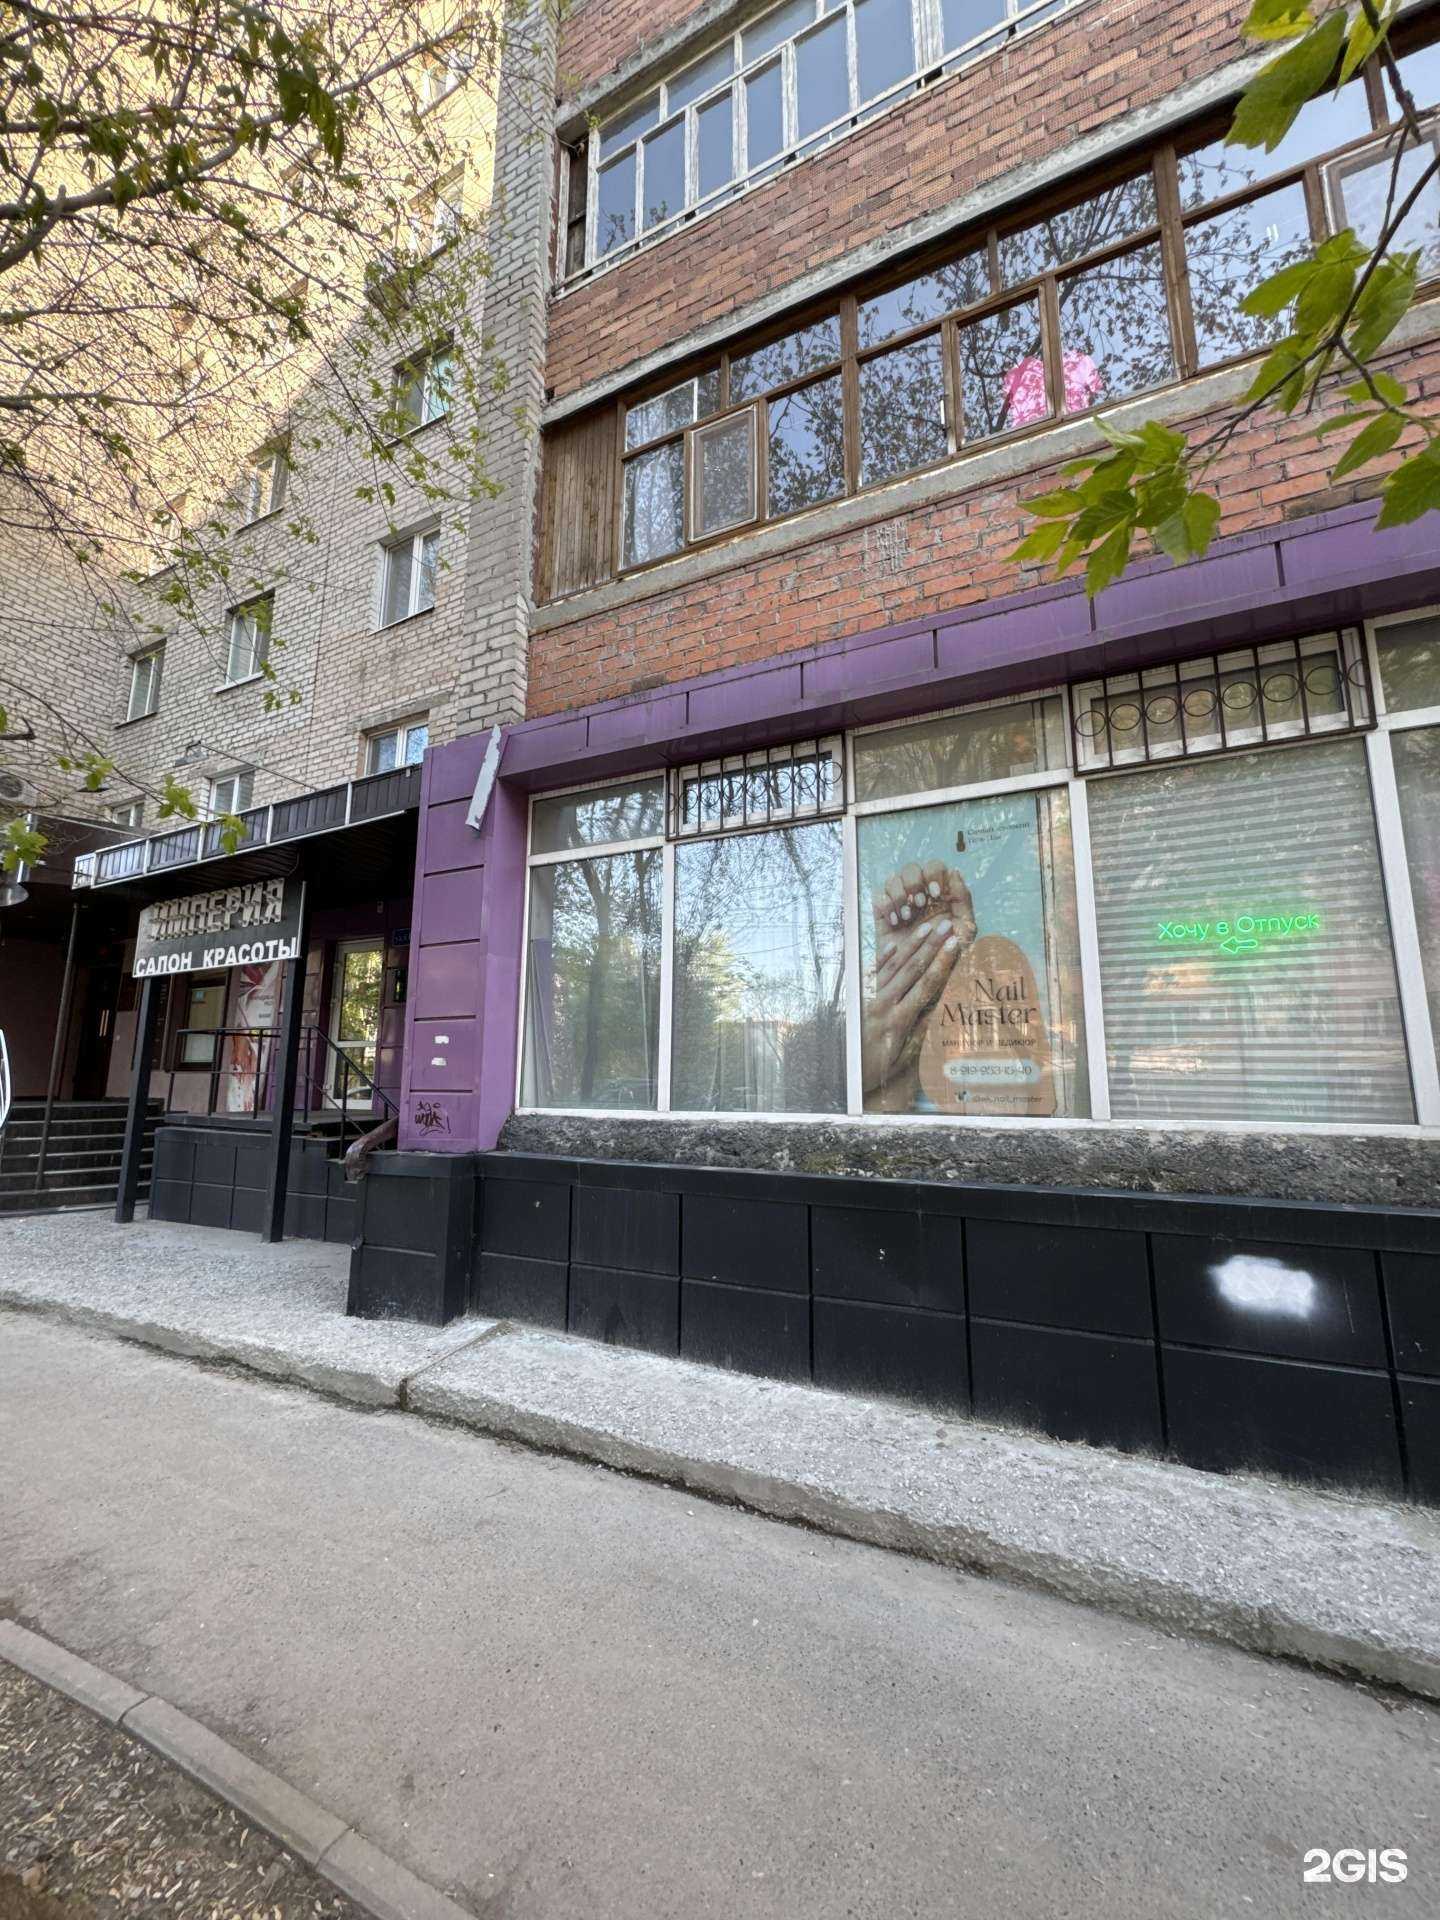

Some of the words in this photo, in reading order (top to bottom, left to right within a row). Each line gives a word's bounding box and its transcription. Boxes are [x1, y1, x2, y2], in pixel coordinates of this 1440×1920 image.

[1157, 921, 1210, 942] Хочу
[1216, 920, 1230, 935] в
[1236, 913, 1321, 936] Отпуск
[135, 951, 193, 976] САЛОН
[202, 936, 298, 969] КРАСОТЫ
[974, 976, 1027, 1002] Nail
[940, 1002, 1038, 1027] Master
